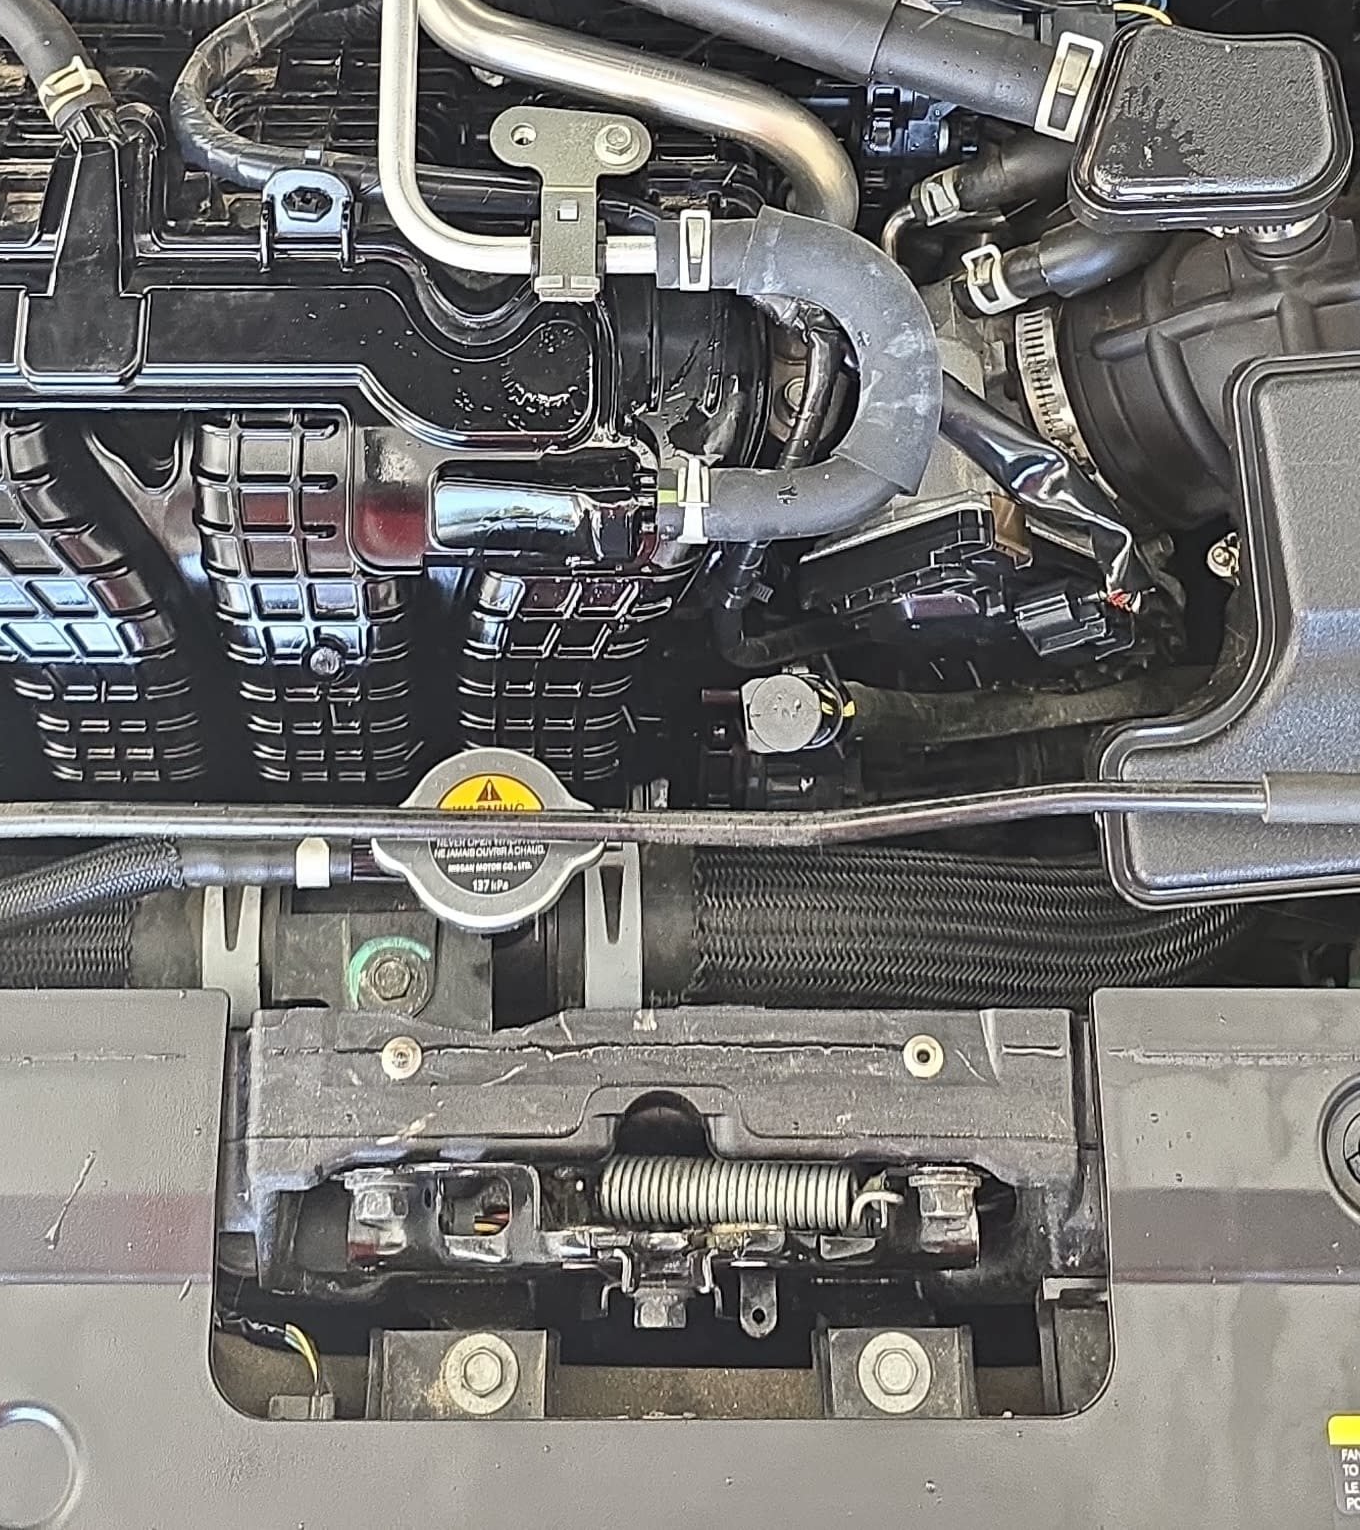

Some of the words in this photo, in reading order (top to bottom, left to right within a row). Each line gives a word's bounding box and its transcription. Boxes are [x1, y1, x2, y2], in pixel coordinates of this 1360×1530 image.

[447, 848, 476, 858] JAMAIS
[476, 863, 502, 872] MOTOR
[472, 879, 490, 892] 137
[491, 879, 509, 891] kPa
[1343, 1464, 1359, 1476] TO
[1345, 1481, 1360, 1494] LE
